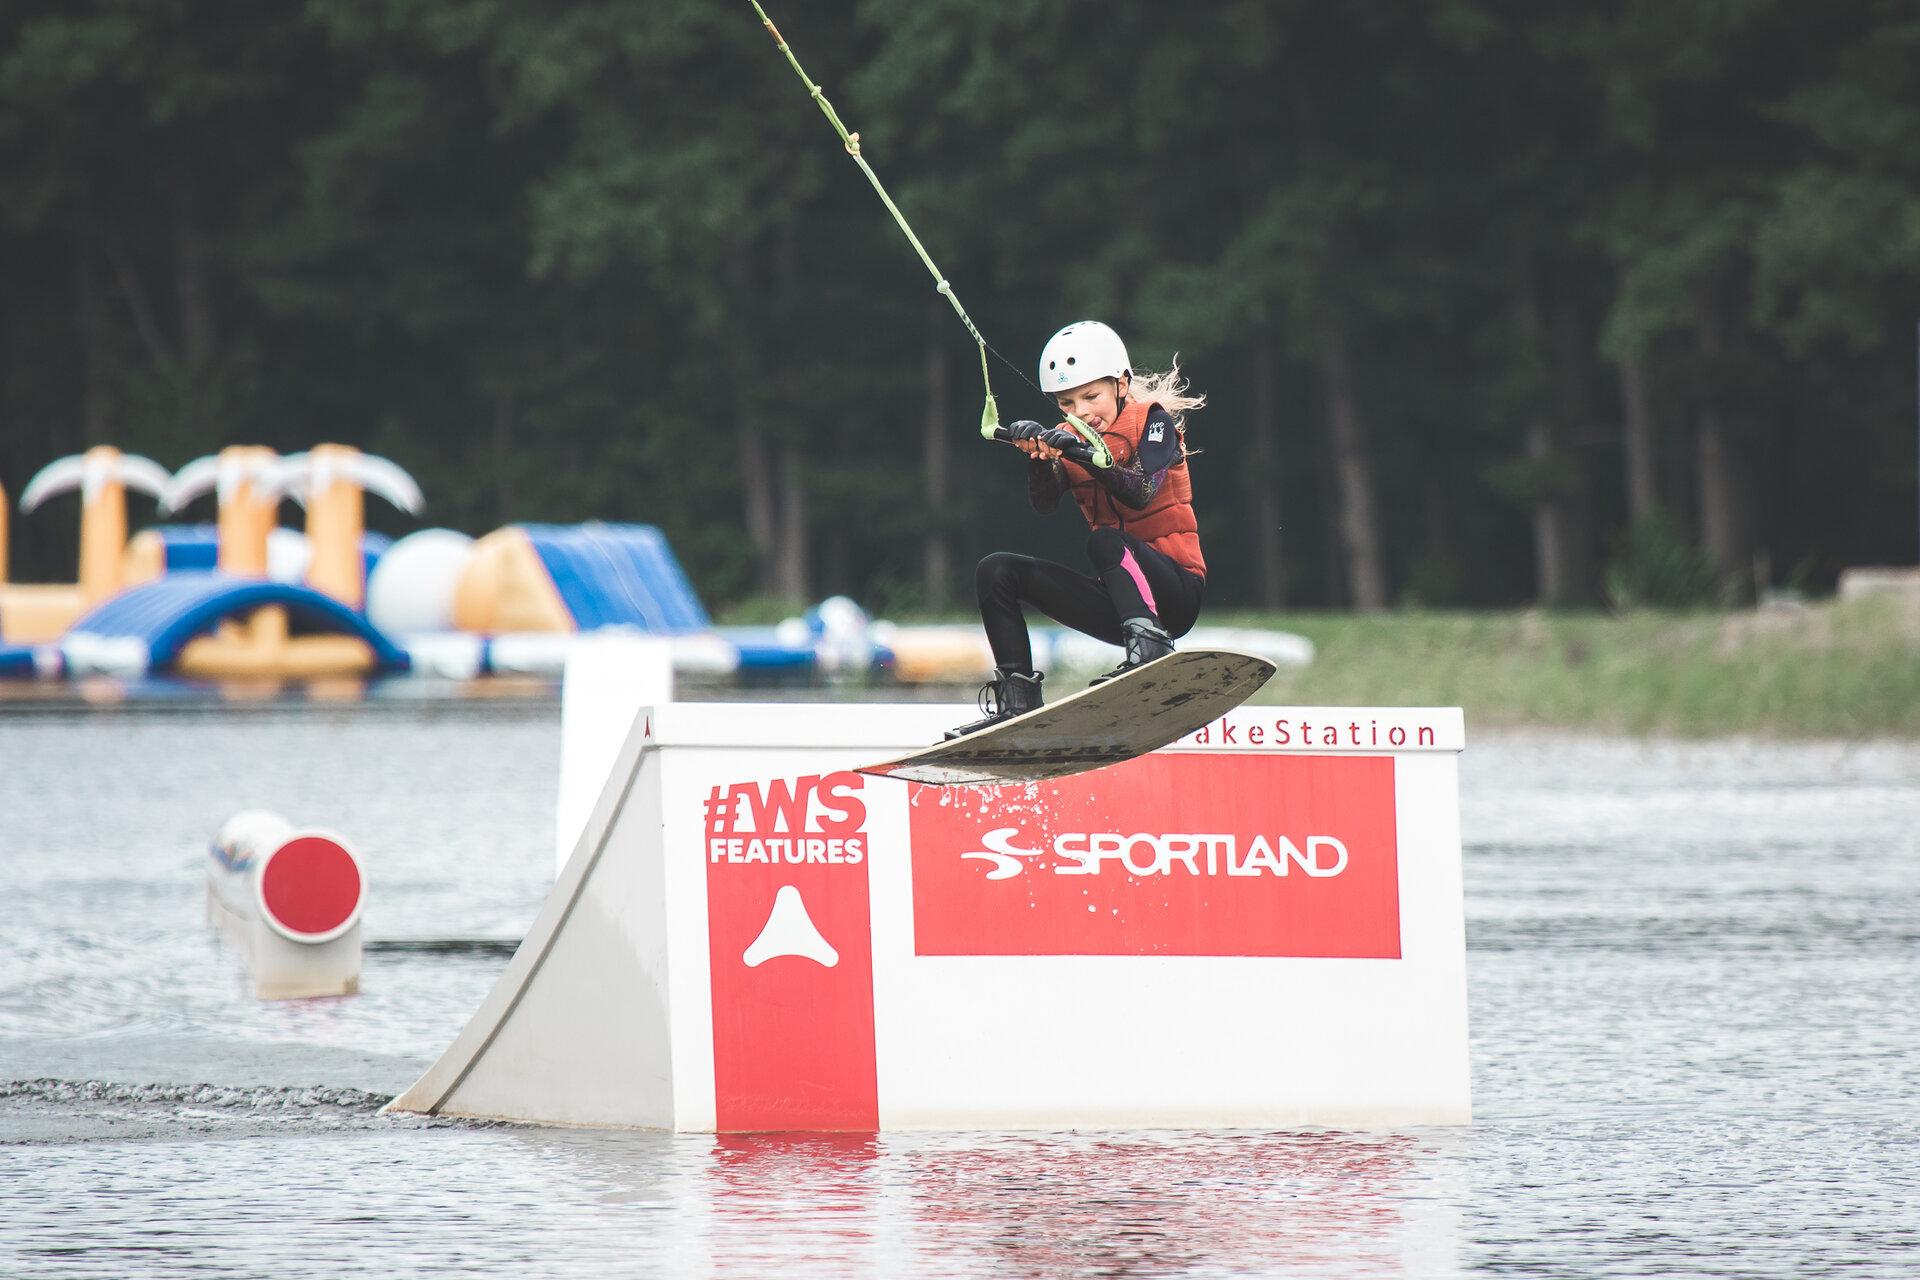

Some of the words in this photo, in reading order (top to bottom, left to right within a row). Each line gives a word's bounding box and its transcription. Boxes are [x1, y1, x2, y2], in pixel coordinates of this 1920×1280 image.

[1173, 717, 1435, 746] akeStation
[709, 838, 864, 865] FEATURES
[1053, 832, 1349, 878] SPORTLAND
